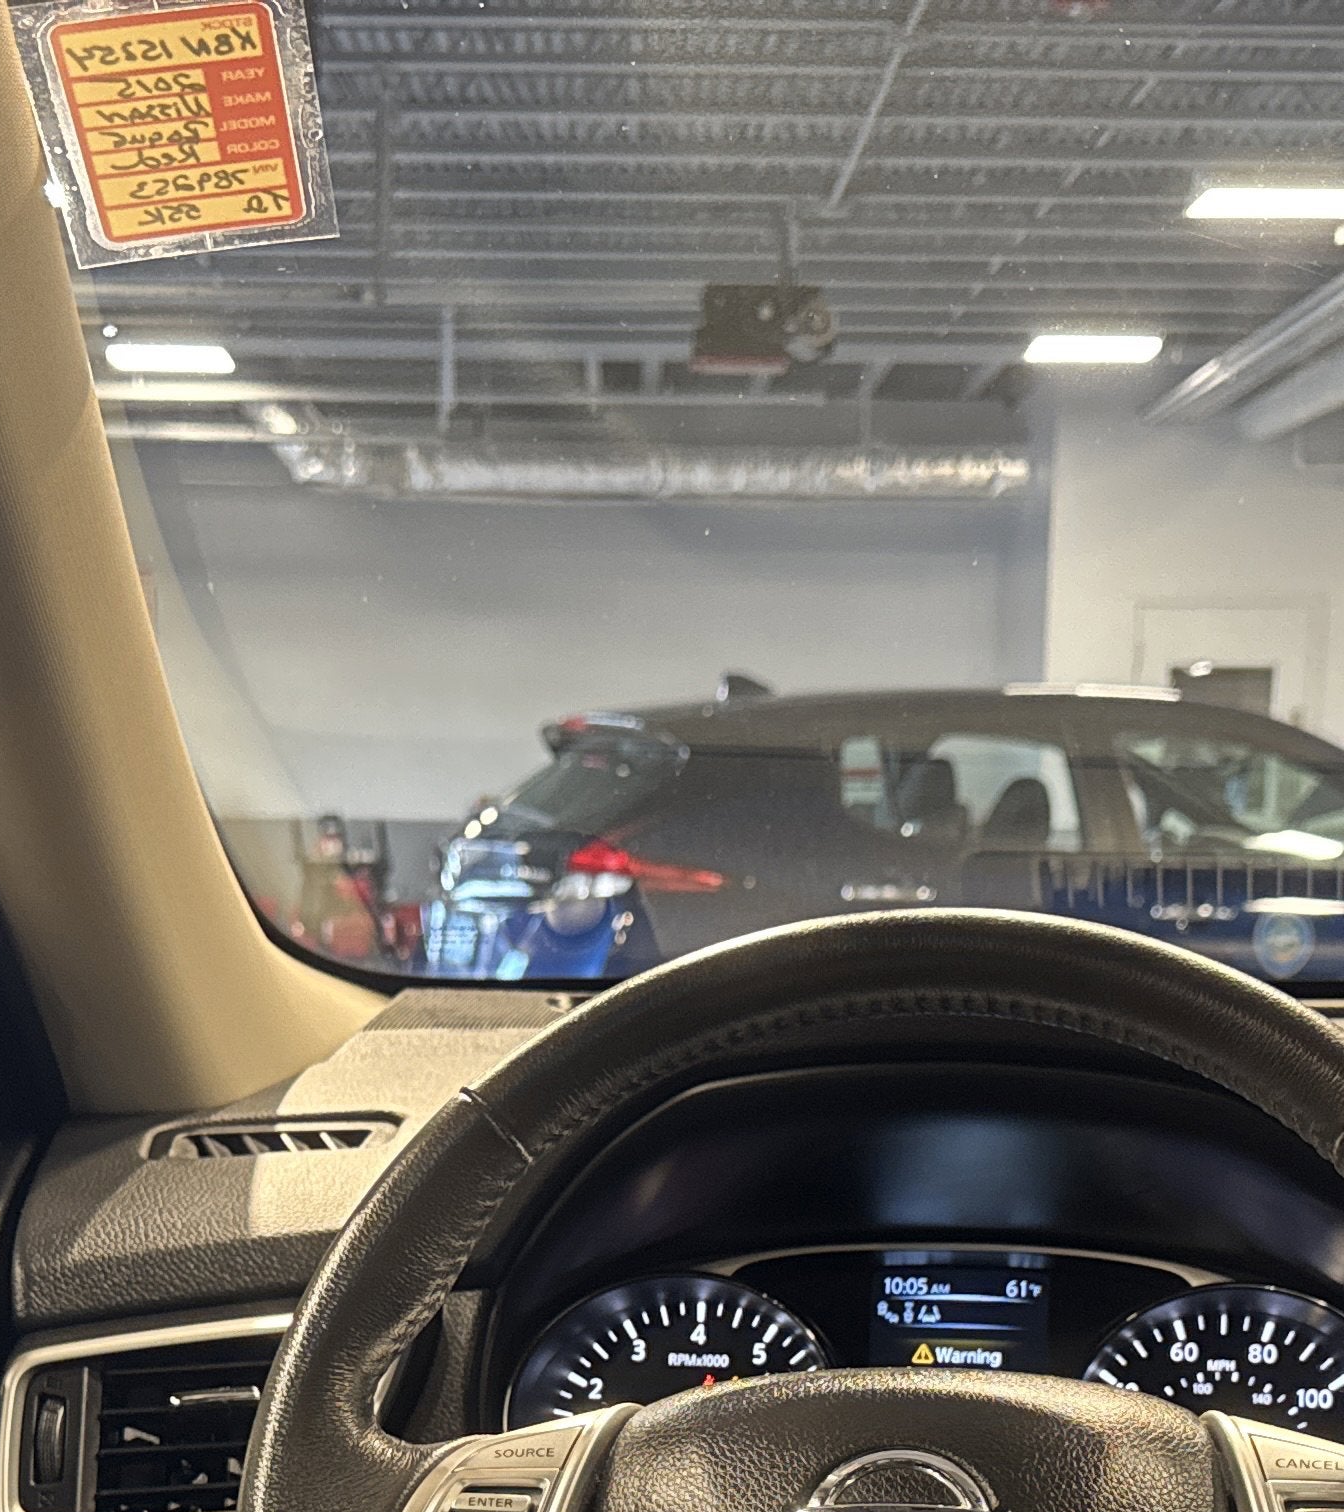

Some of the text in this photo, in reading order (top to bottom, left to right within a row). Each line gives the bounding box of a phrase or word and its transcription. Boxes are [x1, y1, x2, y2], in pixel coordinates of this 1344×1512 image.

[884, 1276, 951, 1295] 10:05 AM
[690, 1323, 707, 1345] 4
[631, 1338, 647, 1362] 3
[752, 1343, 767, 1365] 5
[934, 1346, 1003, 1368] Warning
[1169, 1341, 1200, 1363] 60
[1247, 1343, 1278, 1365] 80
[1206, 1359, 1237, 1372] MPH
[588, 1378, 604, 1400] 2
[1192, 1383, 1214, 1395] 100
[1296, 1388, 1334, 1410] 100
[494, 1447, 555, 1458] SOURCE
[1275, 1457, 1344, 1472] CANCEL
[468, 1497, 514, 1508] ENTER
